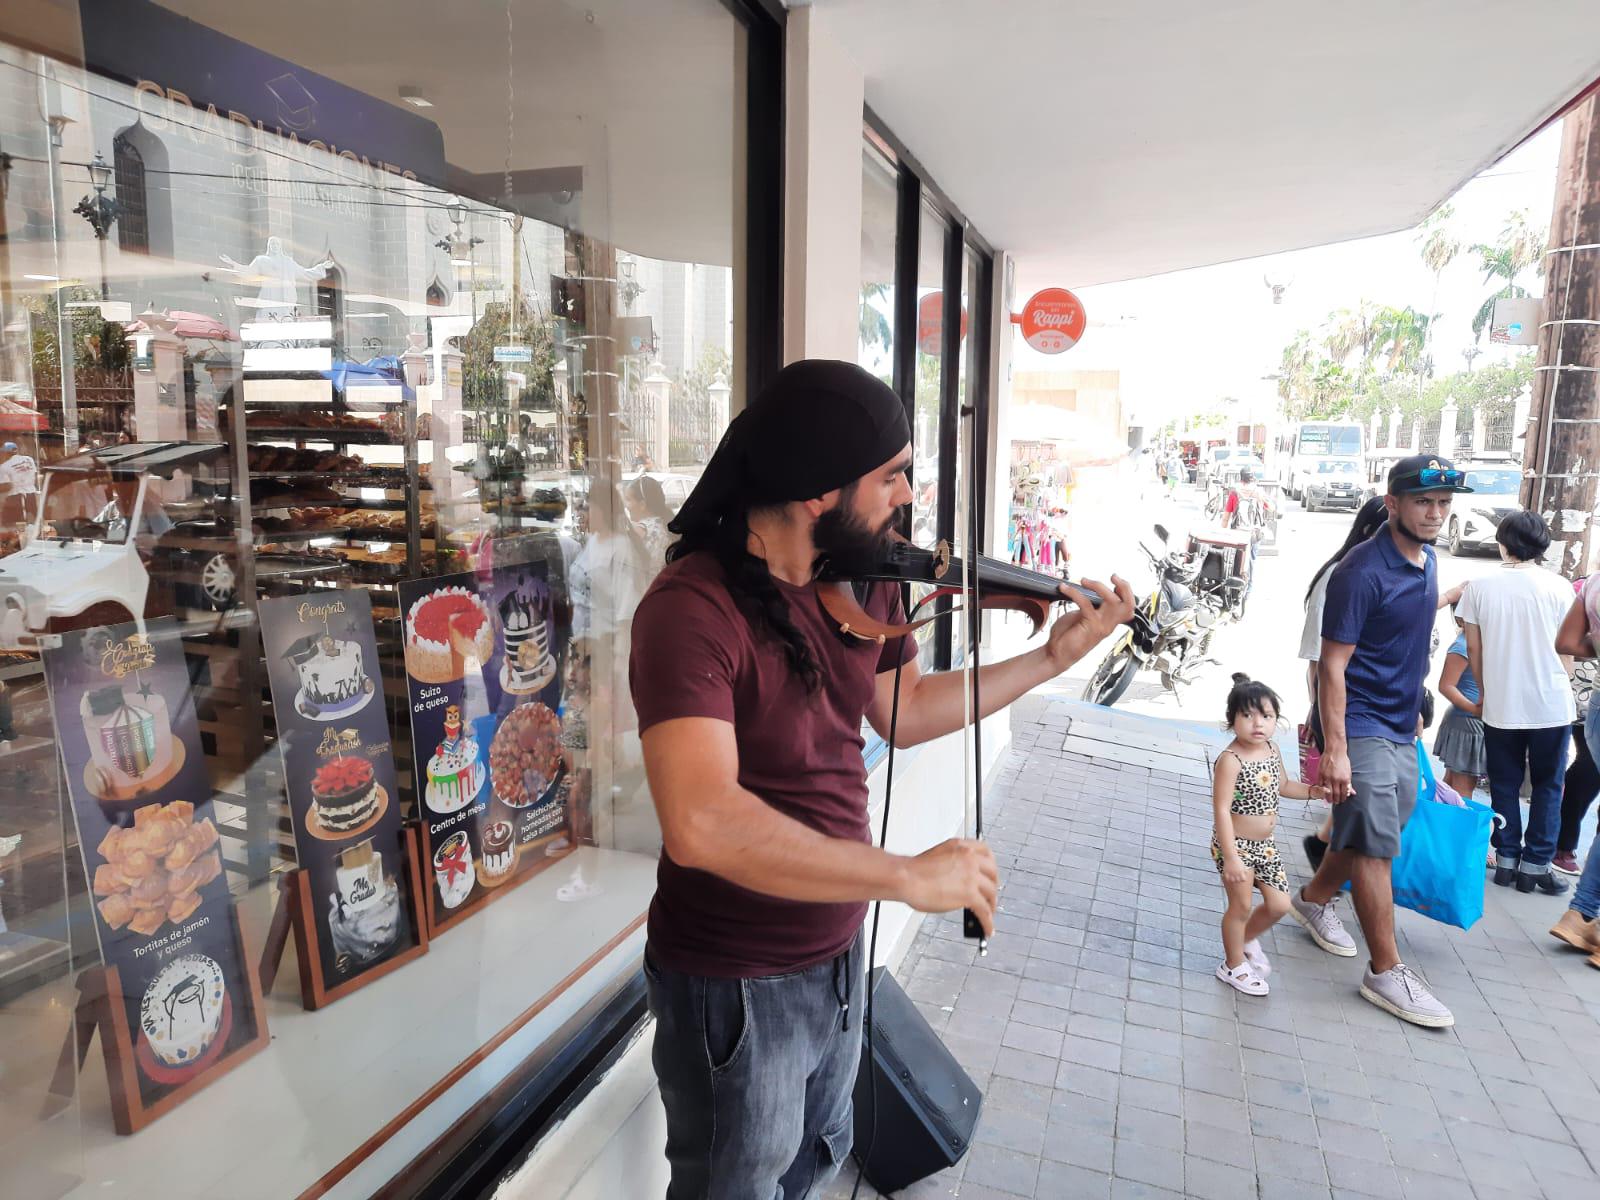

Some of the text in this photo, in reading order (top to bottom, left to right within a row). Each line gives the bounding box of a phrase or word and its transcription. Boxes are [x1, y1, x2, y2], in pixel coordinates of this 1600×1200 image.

[1033, 309, 1075, 328] Rappi
[297, 601, 346, 623] Congrats
[420, 686, 441, 699] Suizo
[414, 696, 449, 713] de queso
[430, 803, 486, 835] Centro de mesa
[526, 800, 558, 821] Salchichas
[552, 807, 563, 819] con
[522, 830, 538, 843] salsa
[133, 916, 210, 958] Tortitas de jamón
[157, 936, 192, 959] y queso
